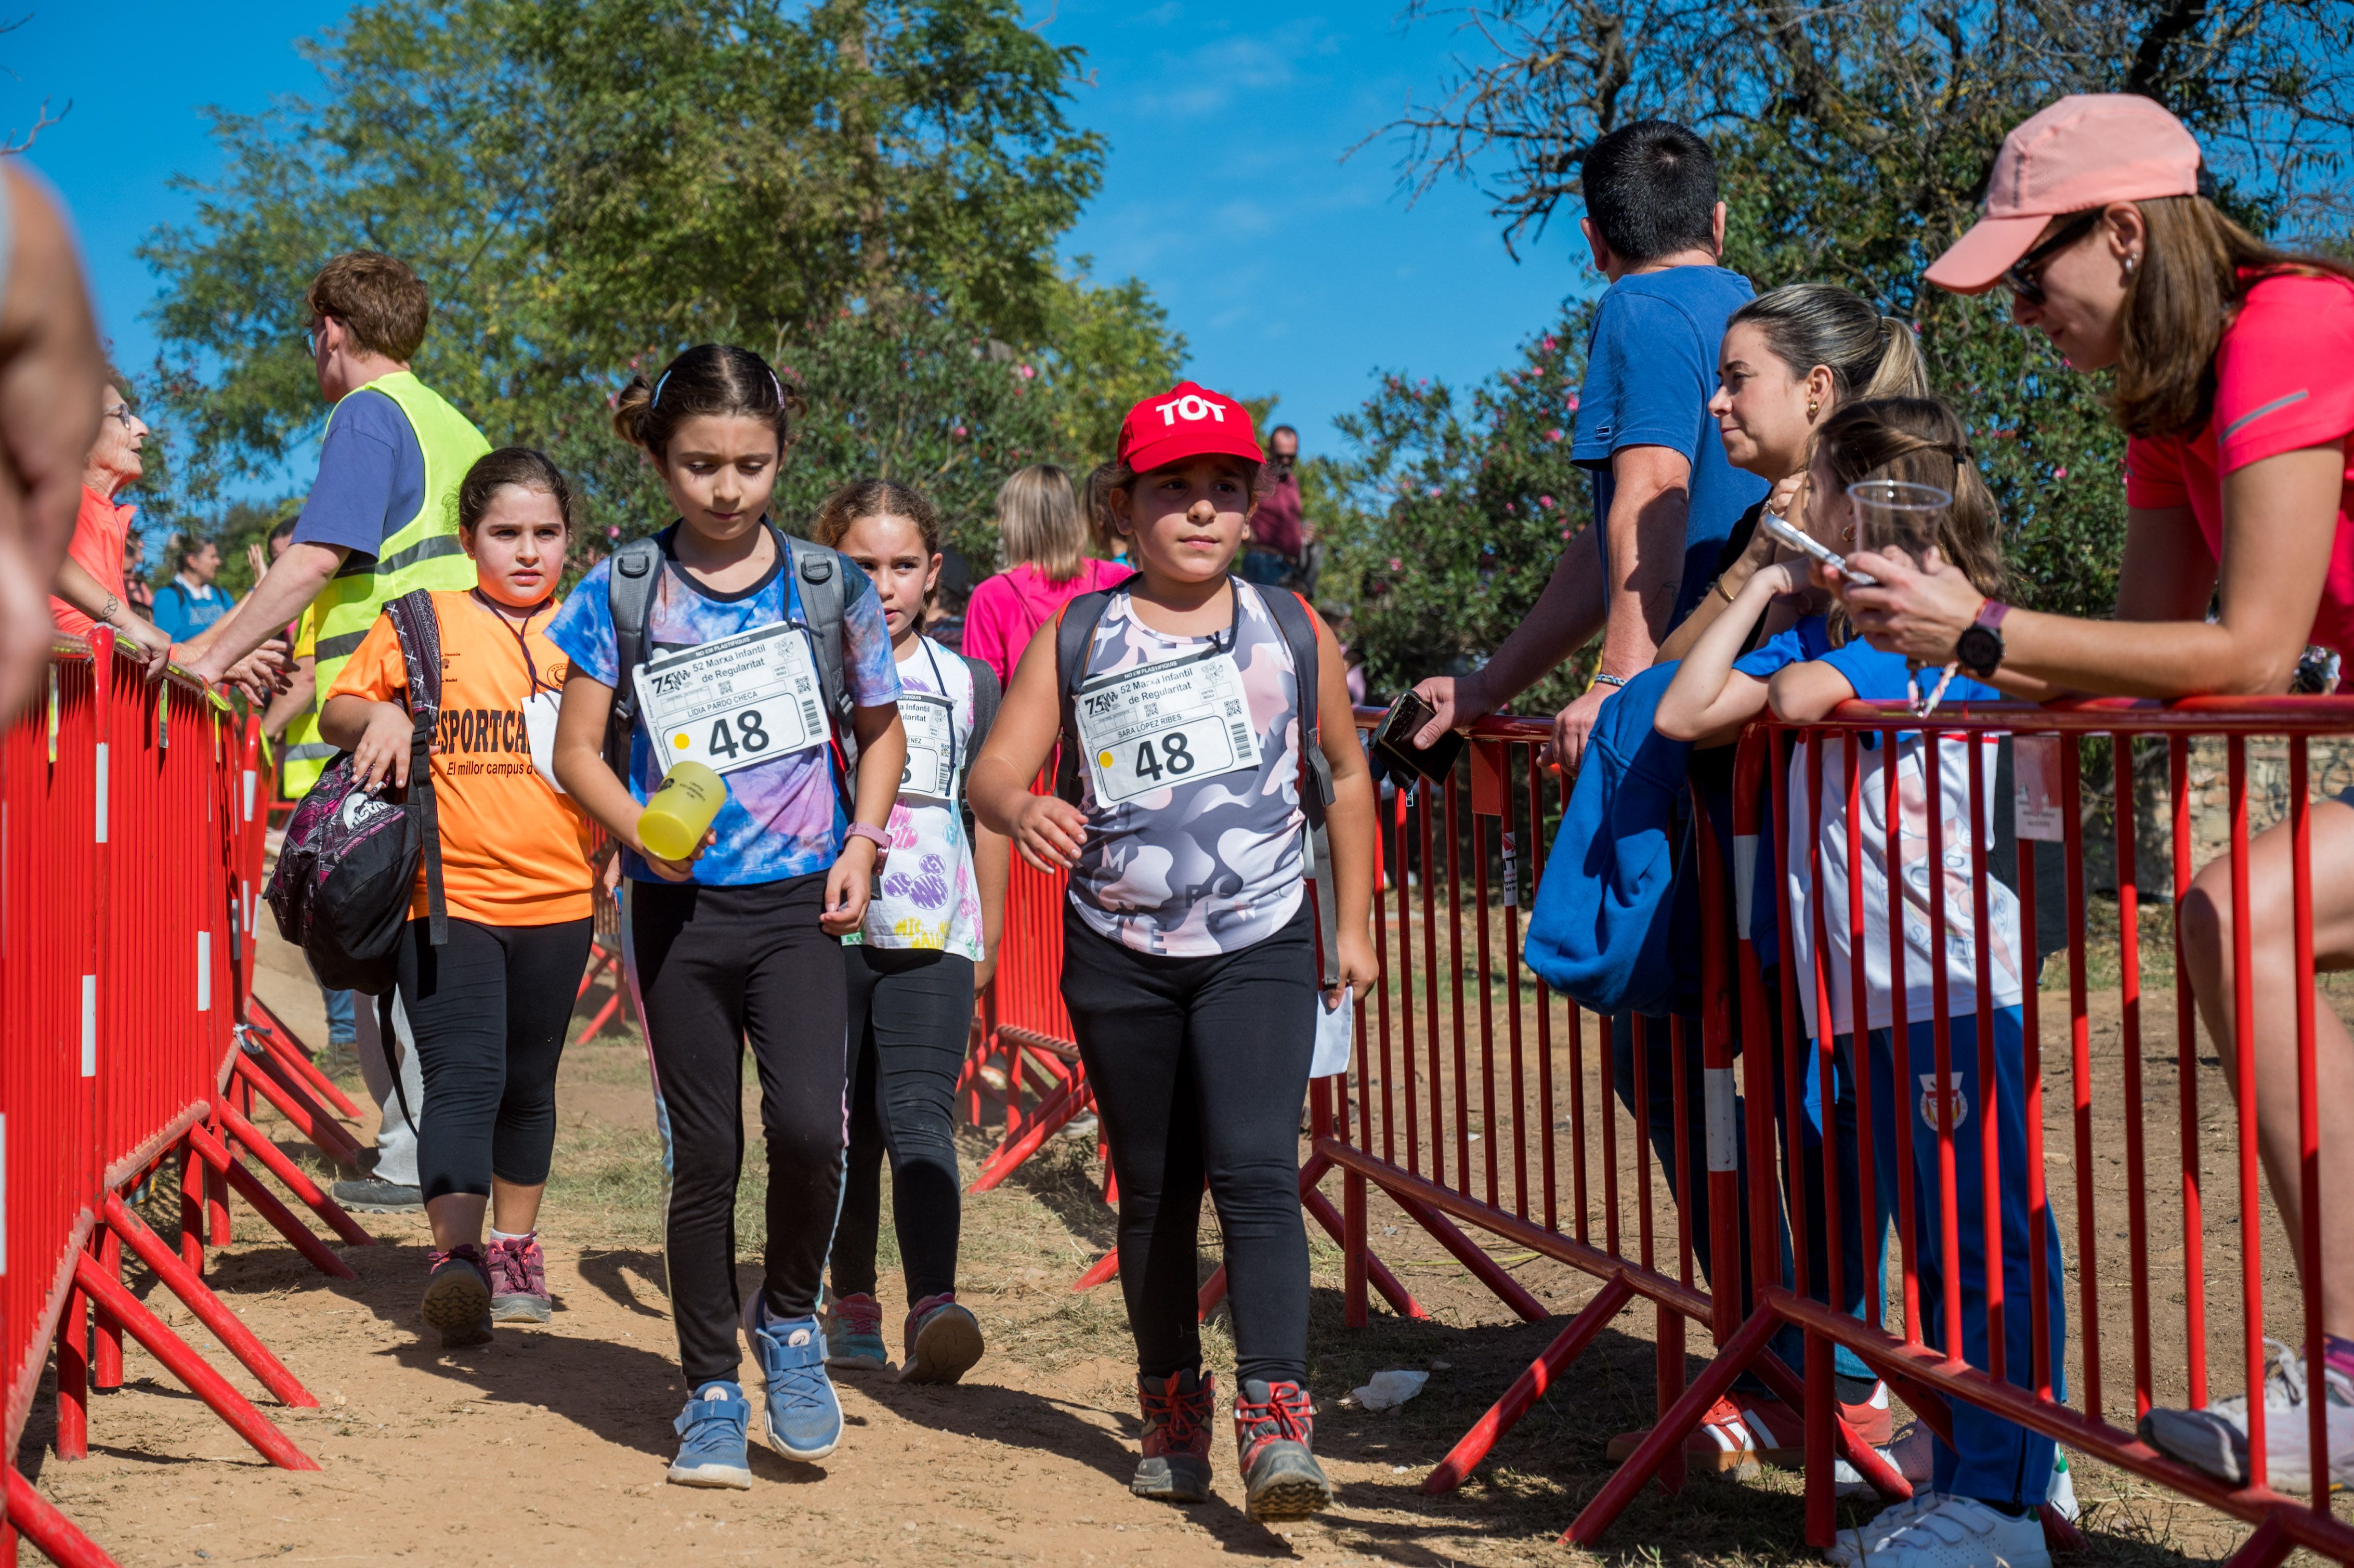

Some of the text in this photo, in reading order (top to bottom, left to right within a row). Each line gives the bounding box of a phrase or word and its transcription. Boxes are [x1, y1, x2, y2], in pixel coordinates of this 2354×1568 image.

[1156, 395, 1226, 426] TOT
[714, 636, 750, 651] PLASTIFIQUIS
[693, 644, 766, 672] 52 Marxa Infantil
[702, 658, 765, 683] de Regularitat
[1141, 661, 1177, 673] PLASTIFIQUIS
[1120, 668, 1193, 694] 52 Marxa Infantil
[1129, 682, 1192, 704] de Regularitat
[687, 691, 758, 717] LÍDIA PARDO CHECA
[906, 703, 930, 712] Infantil
[709, 710, 769, 759] 48
[1118, 714, 1182, 738] SARA LÓPEZ RIBES
[1135, 732, 1195, 781] 48
[447, 762, 456, 775] El
[458, 761, 483, 775] millor
[487, 763, 524, 778] campus
[910, 875, 947, 908] MOUSE
